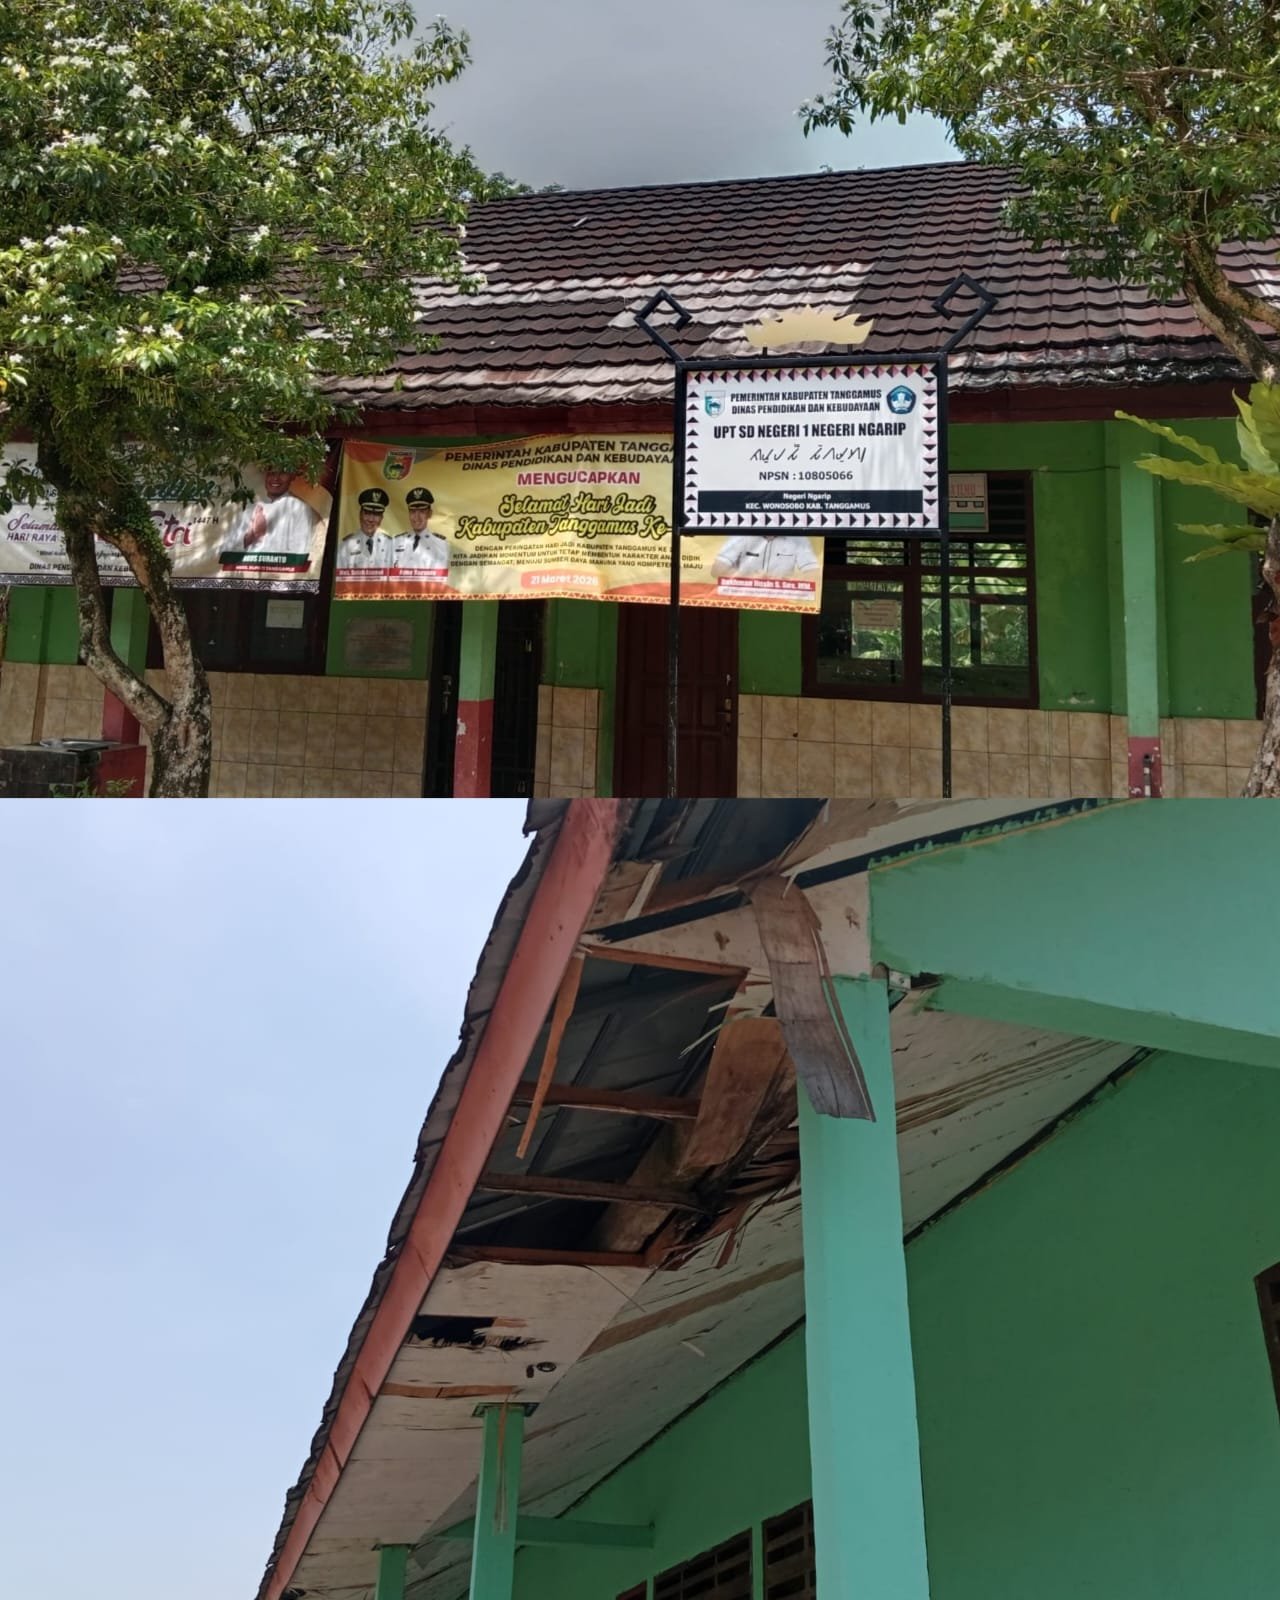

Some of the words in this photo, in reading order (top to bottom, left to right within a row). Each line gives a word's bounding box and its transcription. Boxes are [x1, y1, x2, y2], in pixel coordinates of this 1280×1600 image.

[730, 393, 780, 402] PEMERINTAH
[781, 391, 829, 401] KABUPATEN
[829, 389, 882, 400] TANGGAMUS
[731, 405, 756, 415] DINAS
[757, 403, 806, 414] PENDIDIKAN
[807, 403, 825, 413] DAN
[826, 402, 881, 413] KEBUDAYAAN
[713, 425, 737, 439] UPT
[738, 425, 756, 438] SD
[757, 424, 800, 438] NEGERI
[802, 424, 809, 437] 1
[811, 423, 855, 437] NEGERI
[858, 422, 907, 436] NGARIP
[445, 447, 532, 462] PEMERINTAH
[535, 440, 616, 455] KABUPATEN
[462, 461, 498, 471] DINAS
[500, 453, 573, 469] PENDIDIKAN
[576, 453, 599, 463] DAN
[517, 471, 641, 486] MENGUCAPKAN
[758, 471, 790, 481] NPSN
[798, 470, 854, 481] 10805066
[498, 494, 572, 517] Selamat
[569, 491, 612, 515] Hari
[610, 493, 656, 516] Jadi
[782, 493, 806, 502] Negeri
[807, 493, 832, 502] Ngarip
[745, 503, 761, 511] KEC.
[762, 503, 805, 511] WONOSOBO
[806, 503, 823, 511] KAB.
[824, 503, 871, 511] TANGGAMUS
[454, 515, 550, 541] Kabupaten
[548, 514, 638, 541] Tanggamus
[7, 532, 30, 542] HARI
[31, 532, 58, 543] RAYA
[577, 543, 614, 551] KABUPATEN
[615, 544, 657, 552] TANGGAMUS
[541, 574, 571, 584] Maret
